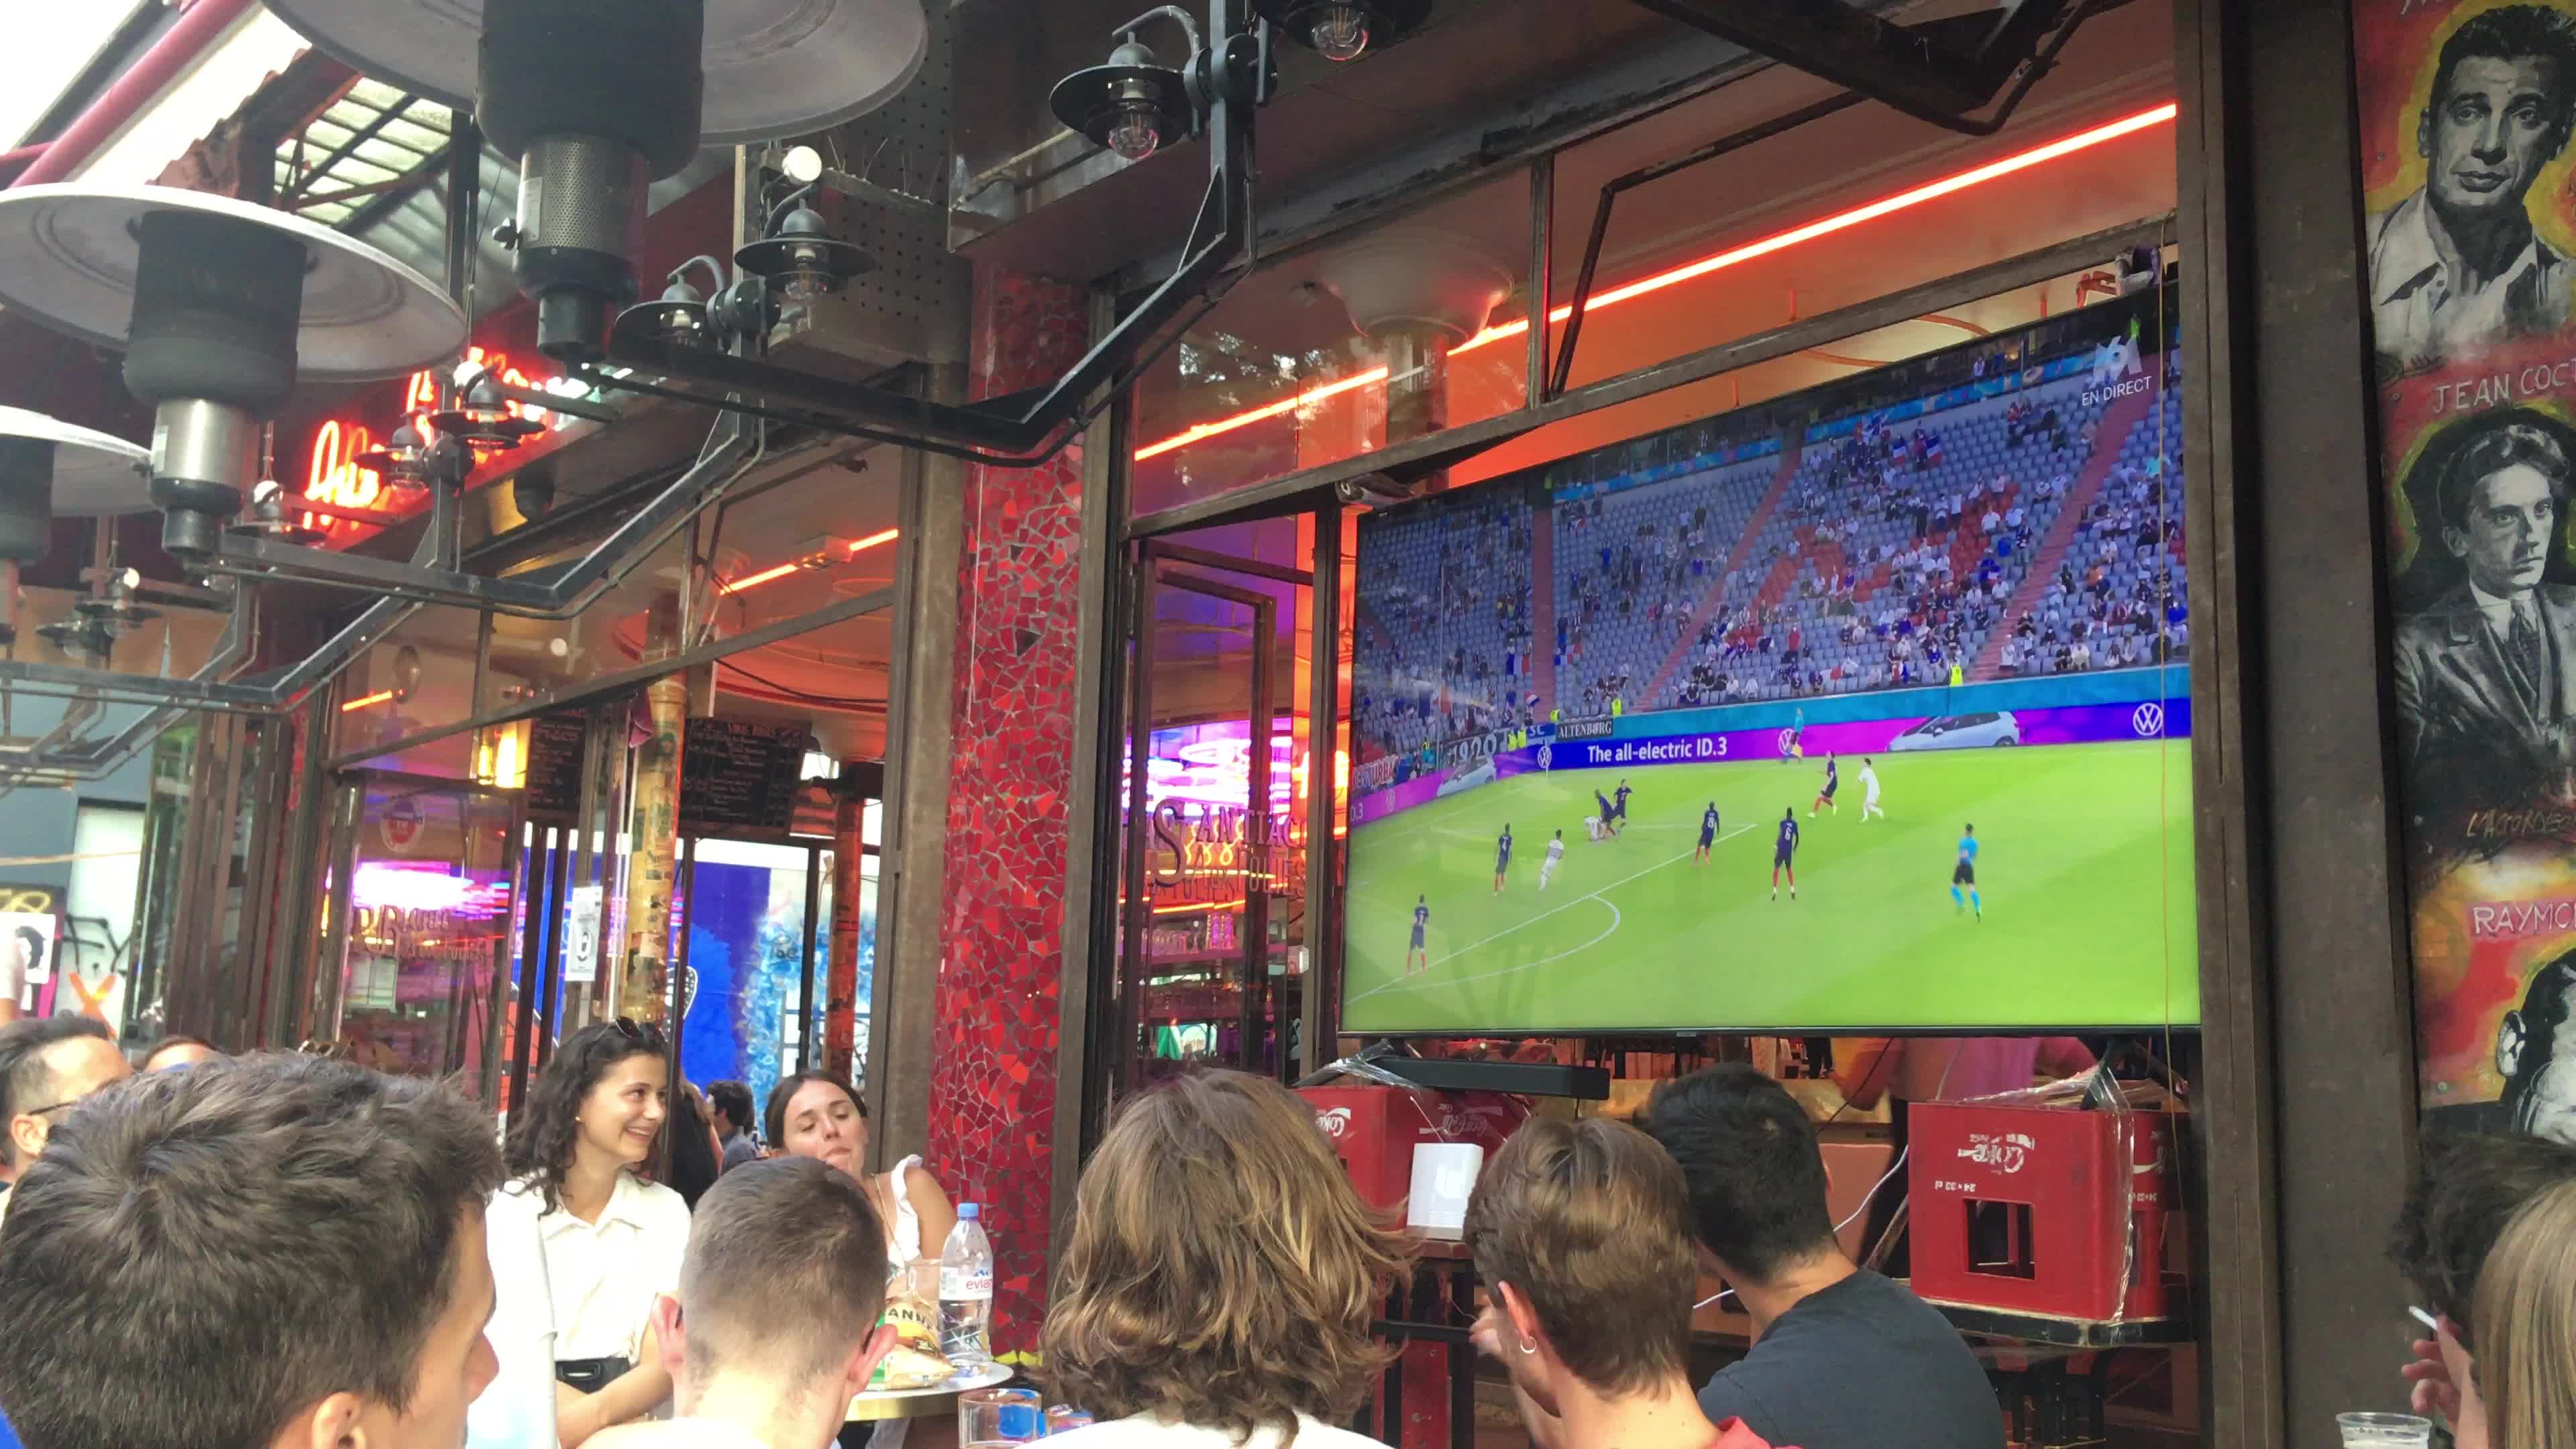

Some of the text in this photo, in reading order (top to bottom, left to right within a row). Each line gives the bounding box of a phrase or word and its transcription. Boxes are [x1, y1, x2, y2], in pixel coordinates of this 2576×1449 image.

[2082, 376, 2152, 407] EN DIRECT
[2431, 374, 2511, 413] JEAN
[1587, 736, 1727, 763] The all-electric ID.3
[2473, 902, 2576, 934] RAYMO
